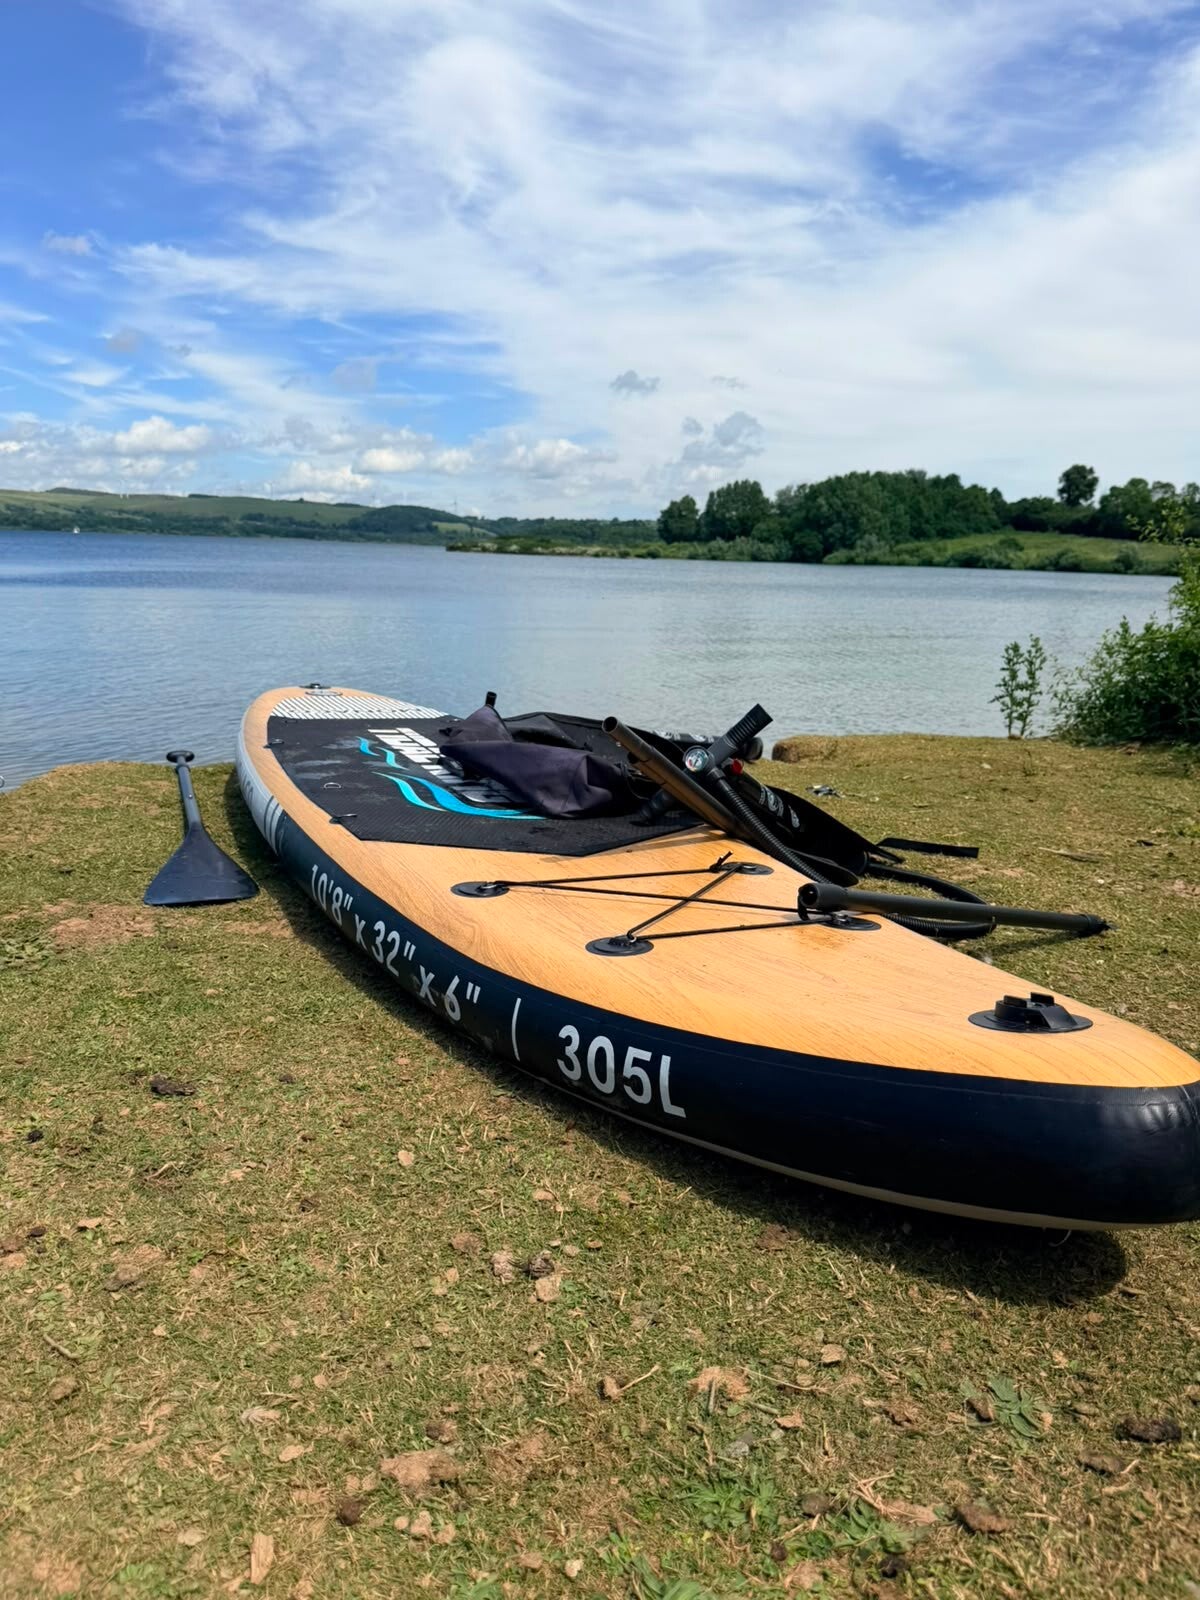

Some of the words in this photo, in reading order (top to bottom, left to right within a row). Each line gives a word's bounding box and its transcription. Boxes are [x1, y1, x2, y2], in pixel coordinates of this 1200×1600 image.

[311, 864, 354, 925] 10'8"
[371, 920, 417, 977] 32"
[444, 975, 481, 1021] 6"
[557, 1024, 686, 1118] 305L
